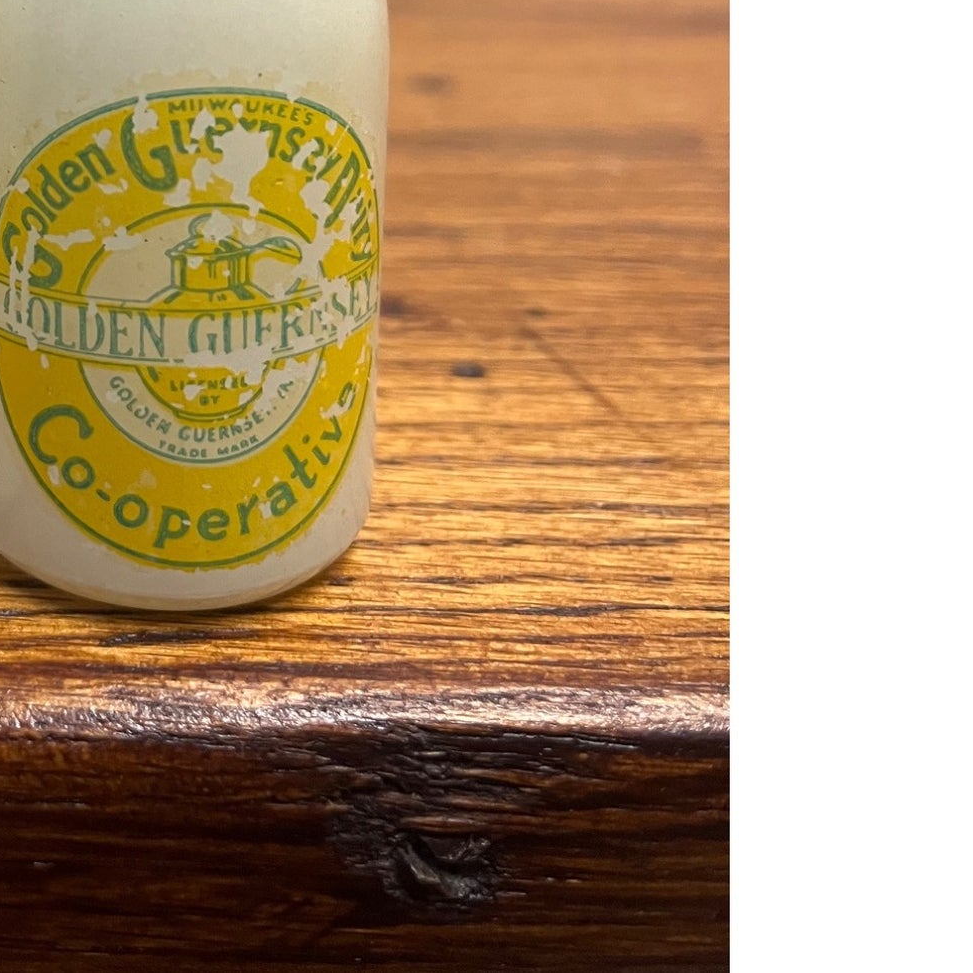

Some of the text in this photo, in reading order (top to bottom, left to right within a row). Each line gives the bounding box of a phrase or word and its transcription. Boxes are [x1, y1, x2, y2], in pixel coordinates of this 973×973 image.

[120, 113, 342, 193] Guensey
[324, 151, 372, 261] Diry
[109, 376, 173, 436] GOLDEN
[158, 434, 260, 458] TRADE MARK
[28, 381, 357, 549] Co-operative
